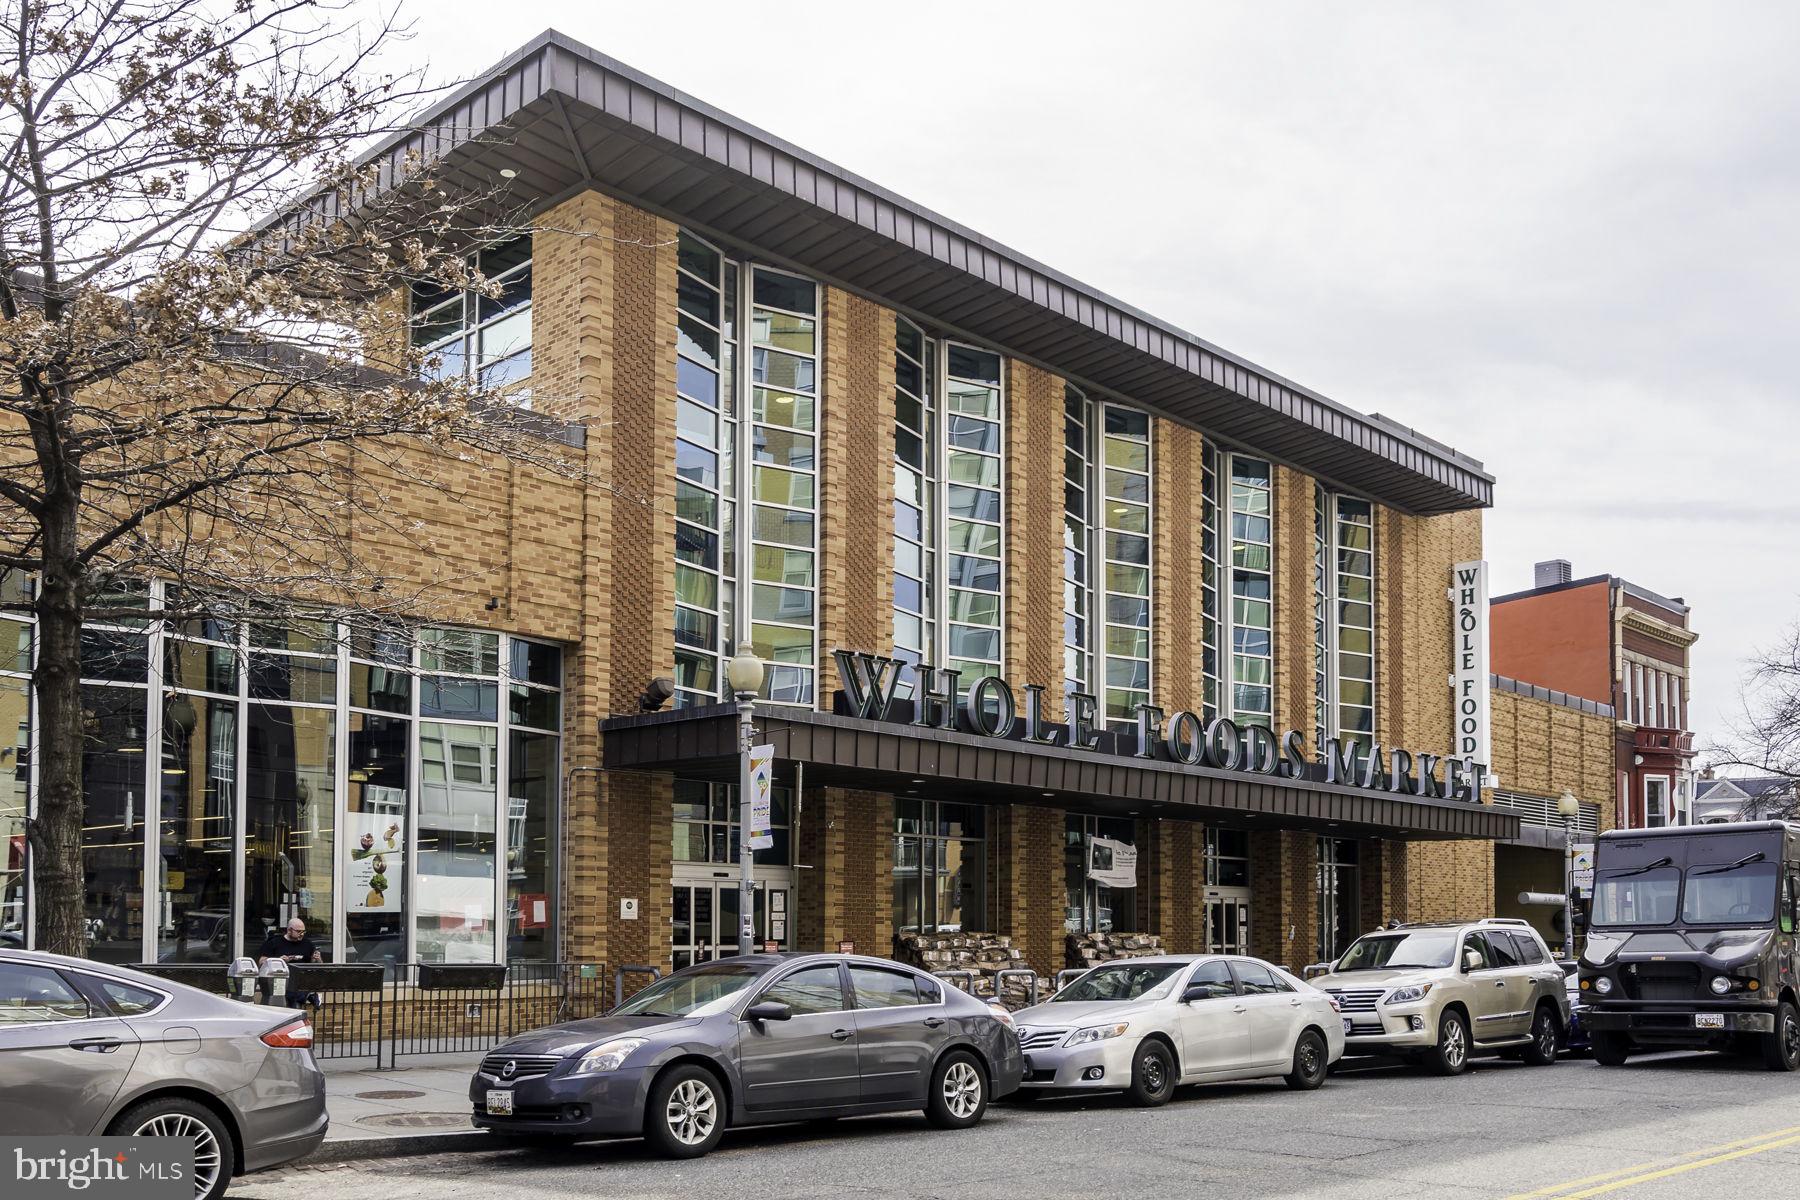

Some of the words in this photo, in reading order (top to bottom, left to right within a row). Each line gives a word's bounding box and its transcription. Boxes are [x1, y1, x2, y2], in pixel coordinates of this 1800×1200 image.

[1457, 568, 1478, 670] WHOLE
[831, 650, 1099, 751] WHOLE
[1134, 702, 1306, 780] FOODS
[1325, 737, 1487, 804] MARKET
